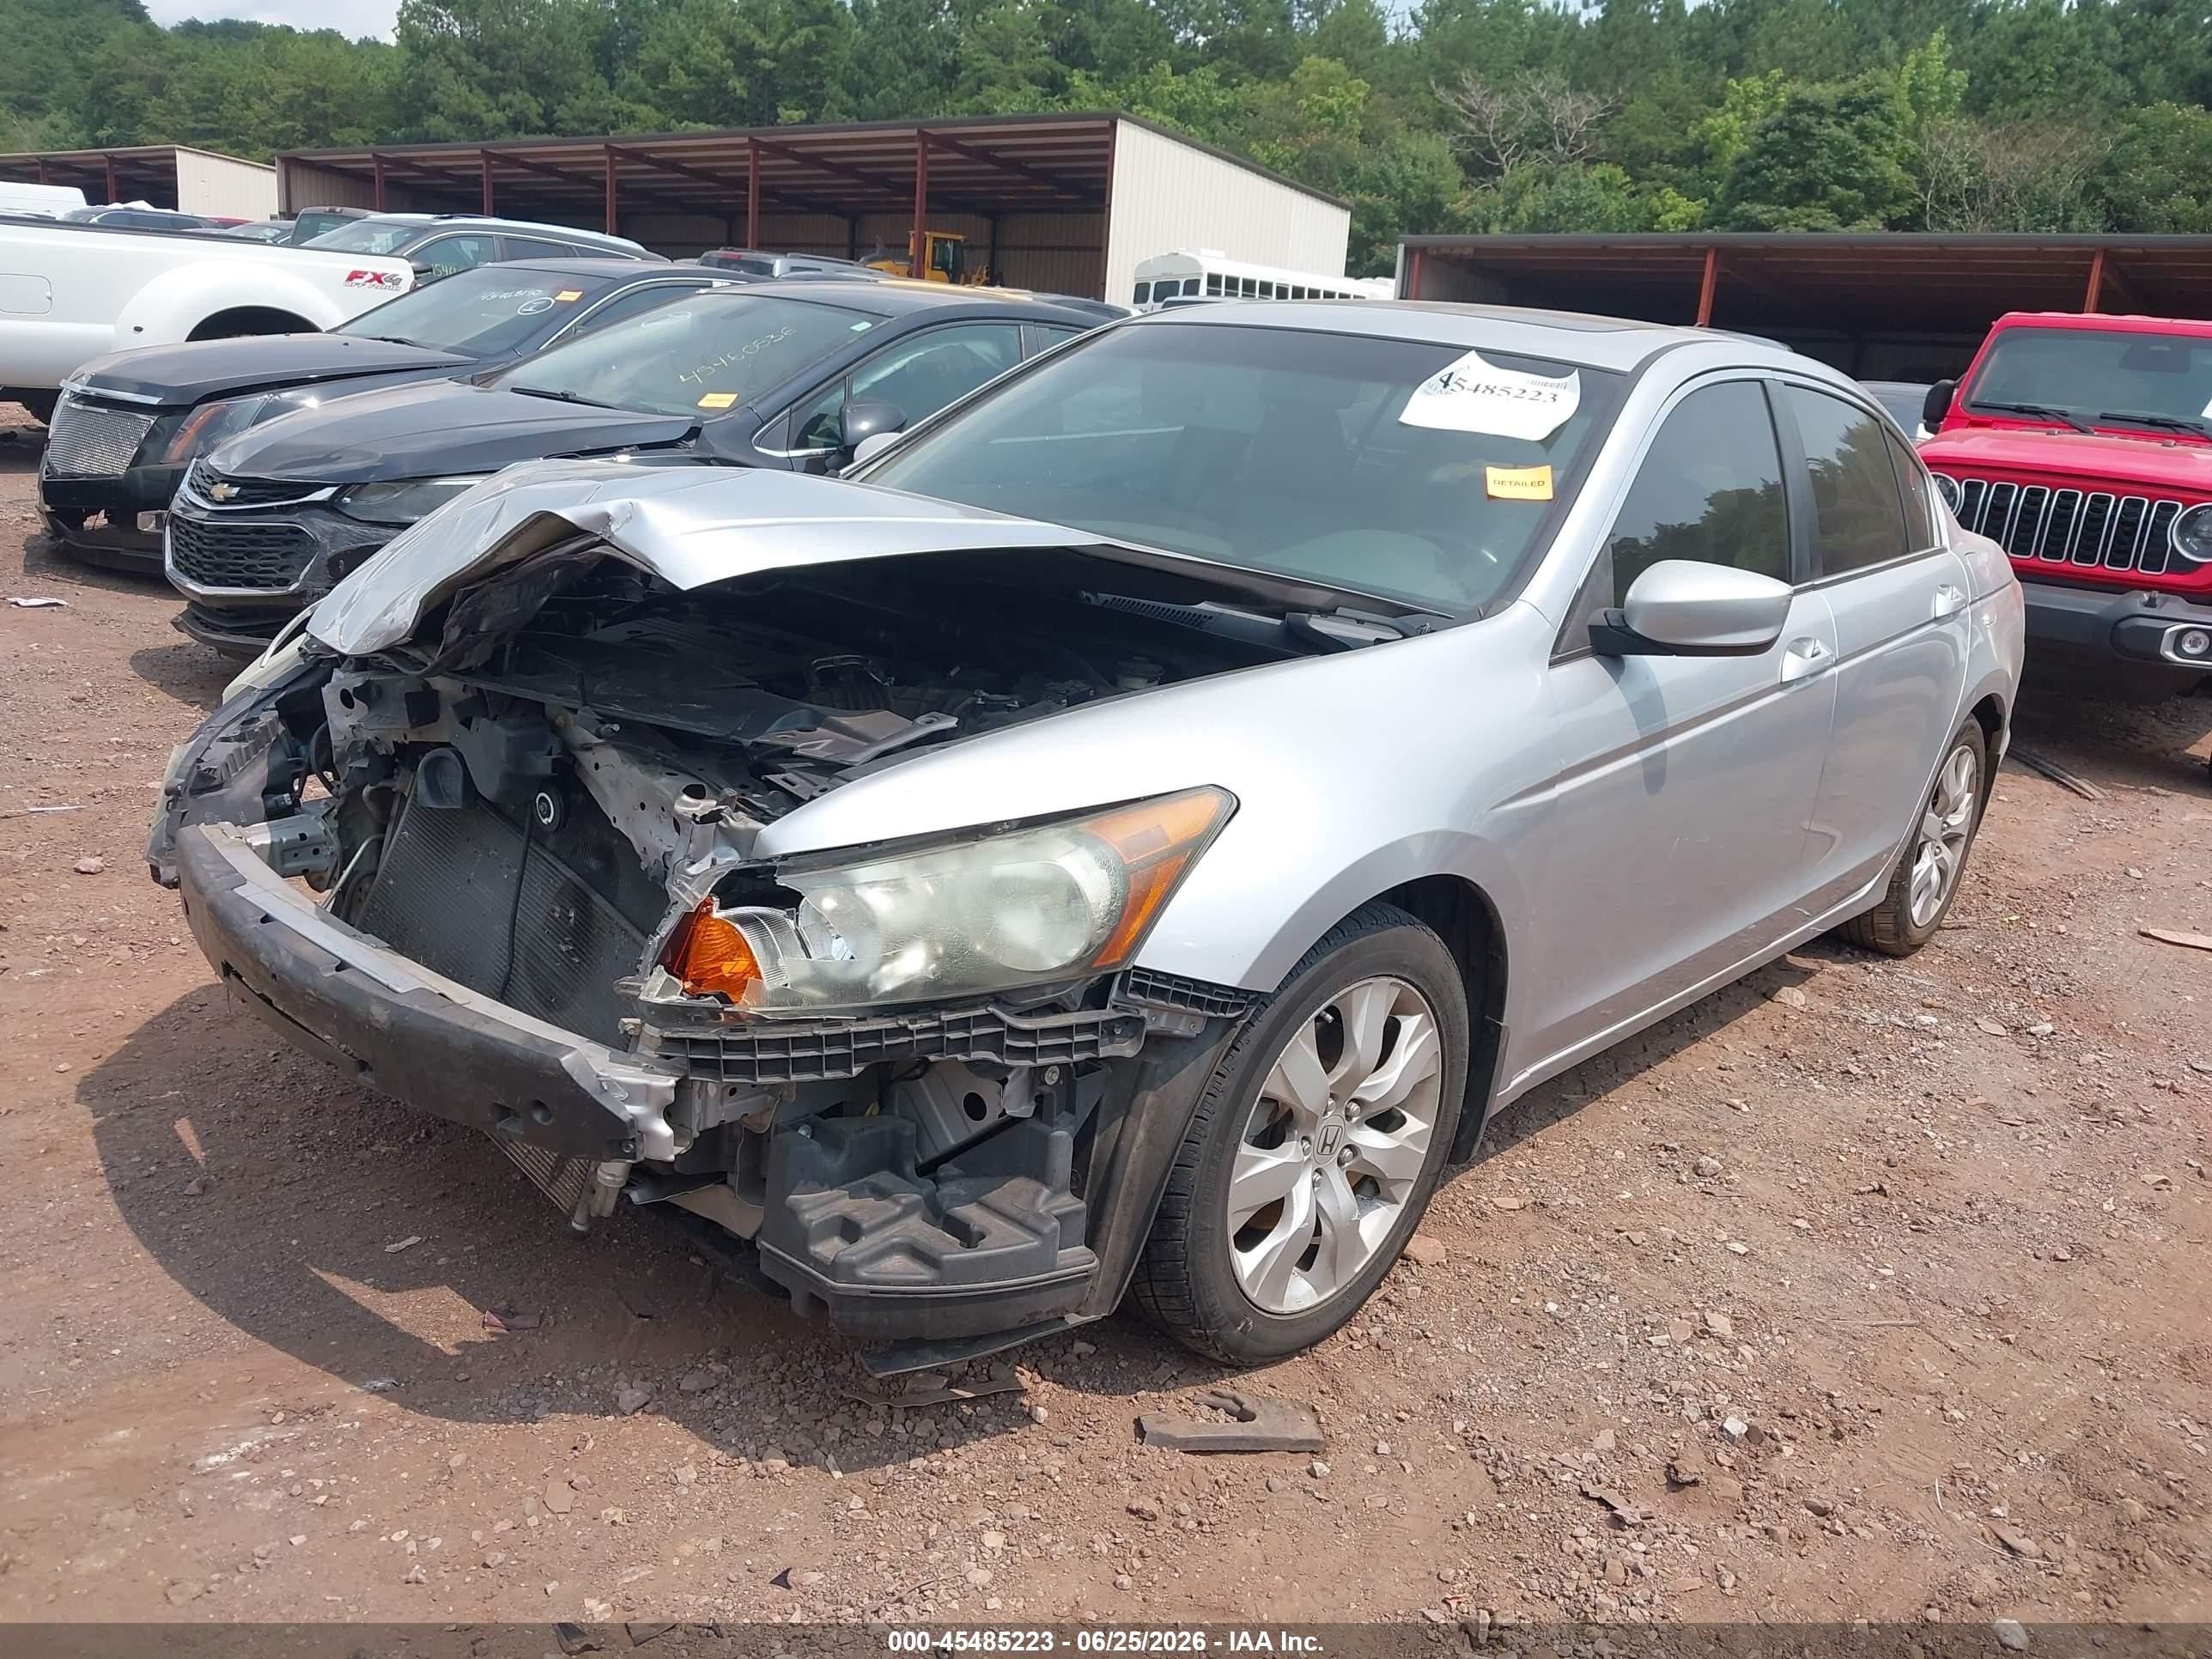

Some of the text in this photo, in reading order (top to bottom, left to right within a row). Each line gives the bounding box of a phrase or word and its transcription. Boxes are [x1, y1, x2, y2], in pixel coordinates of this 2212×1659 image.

[345, 270, 404, 286] FX4
[1438, 371, 1559, 404] 45485223
[1493, 479, 1546, 488] DETAILED
